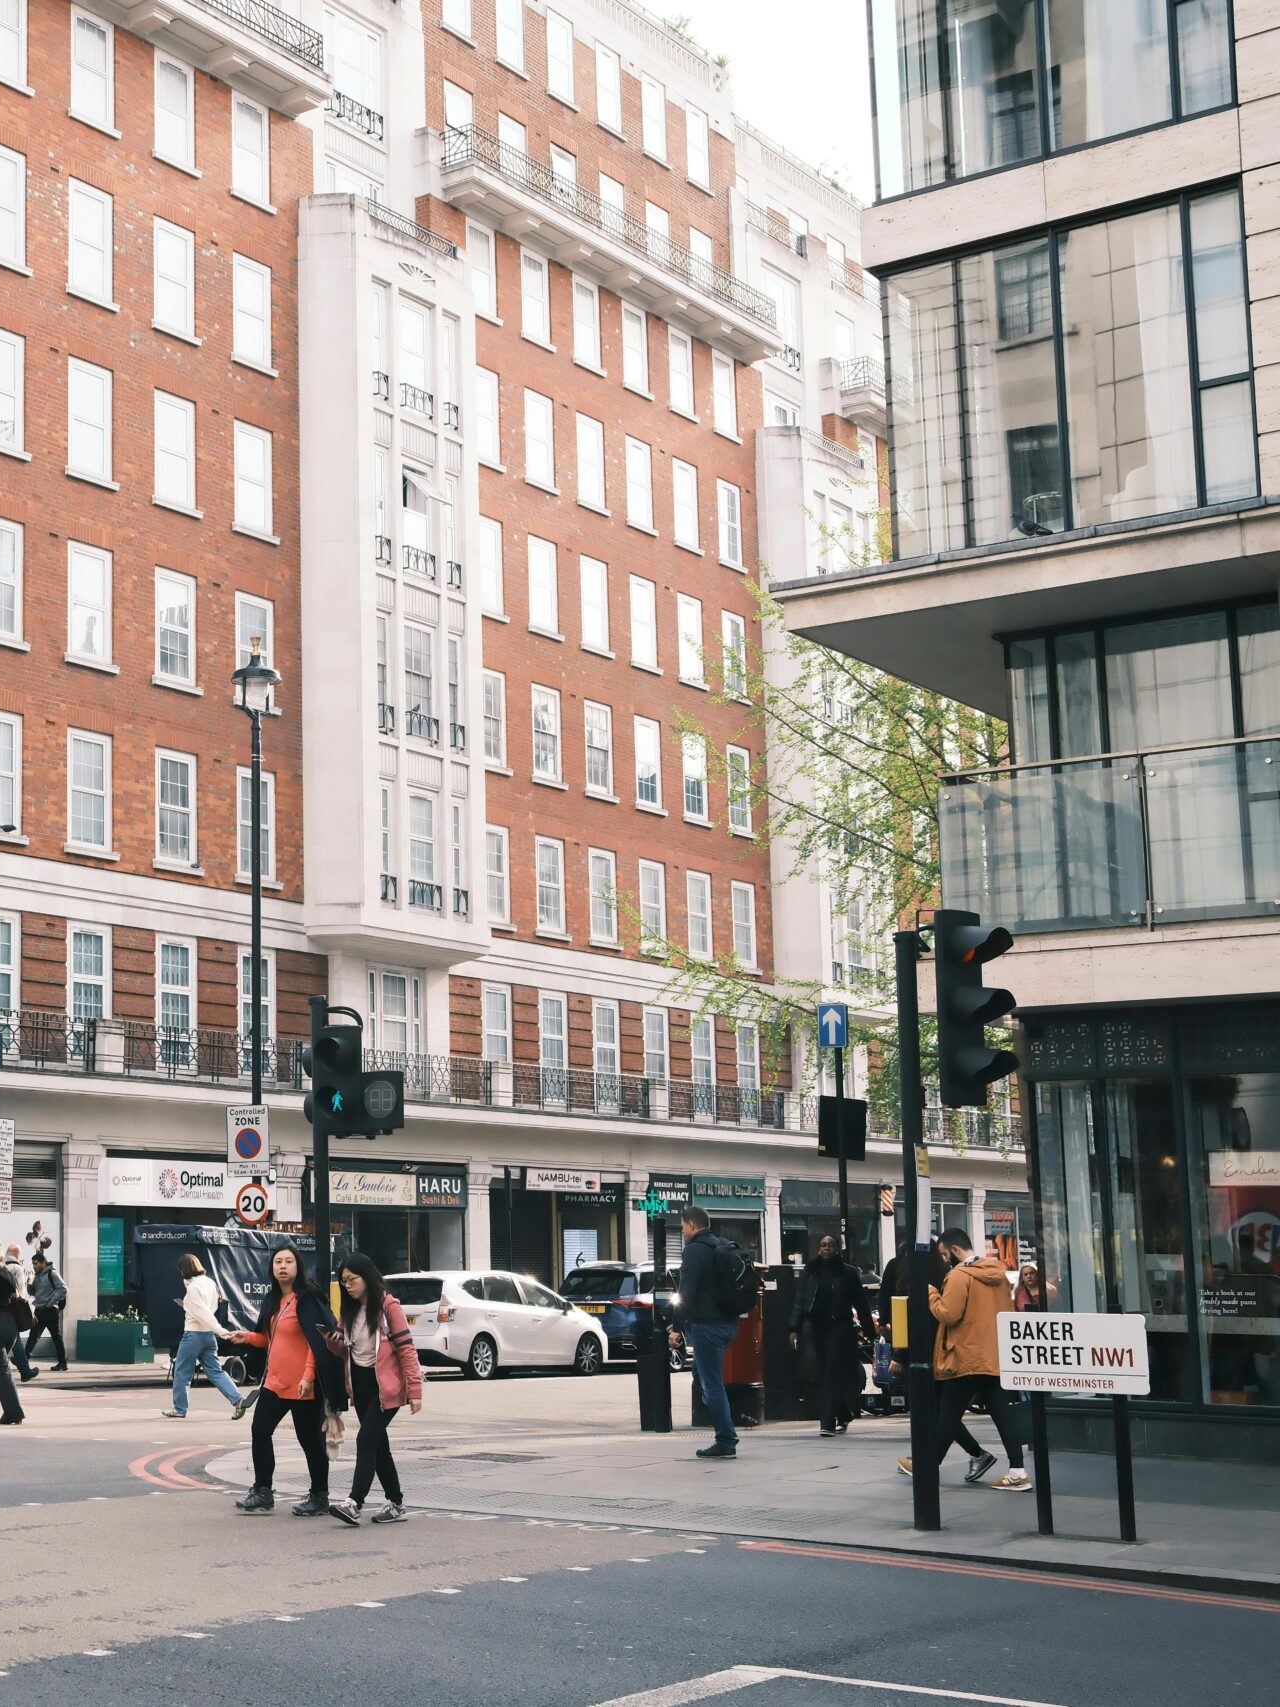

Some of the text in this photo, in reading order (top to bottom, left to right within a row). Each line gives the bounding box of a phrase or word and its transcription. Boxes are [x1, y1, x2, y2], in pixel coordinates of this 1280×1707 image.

[230, 1108, 266, 1116] Controlled
[234, 1117, 260, 1126] ZONE
[180, 1171, 224, 1189] Optimal
[331, 1173, 397, 1192] La Gauloise
[538, 1173, 582, 1183] NAMBU-tei
[419, 1178, 460, 1193] HARU
[180, 1188, 224, 1200] Dental Health
[336, 1194, 393, 1204] Café & Patisserie
[242, 1196, 265, 1212] 20
[421, 1195, 459, 1205] Sushi & Deli
[147, 1231, 187, 1240] sandfords.com
[1200, 1297, 1220, 1306] freshly
[1200, 1307, 1222, 1315] drying
[1010, 1321, 1074, 1341] BAKER
[1011, 1345, 1134, 1367] STREET NW1
[1013, 1376, 1114, 1389] CITY OF WESTMINSTER
